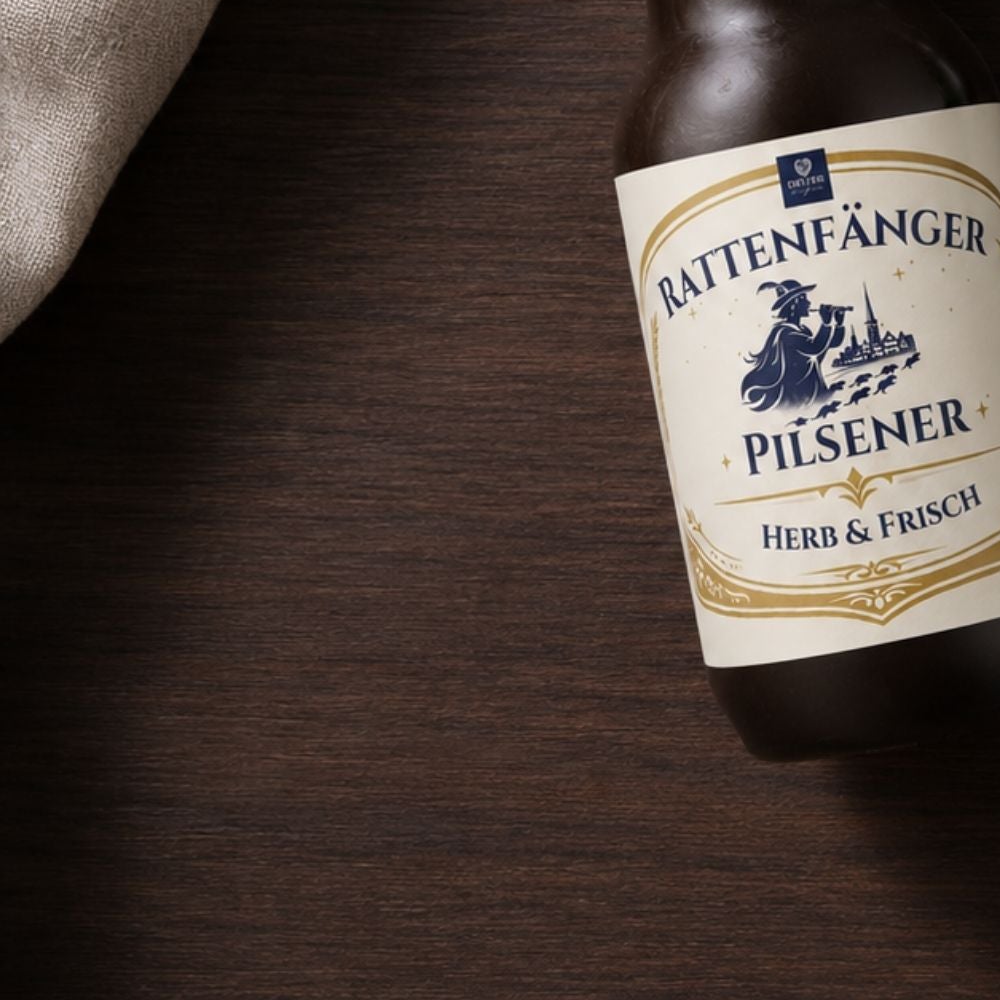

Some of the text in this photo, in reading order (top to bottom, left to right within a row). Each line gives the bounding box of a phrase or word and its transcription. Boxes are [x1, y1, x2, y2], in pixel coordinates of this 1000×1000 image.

[657, 201, 988, 320] RATTENFÄNGER
[741, 398, 971, 477] PILSENER
[762, 523, 838, 551] HERB
[845, 519, 873, 545] &
[878, 483, 982, 539] FRISCH
